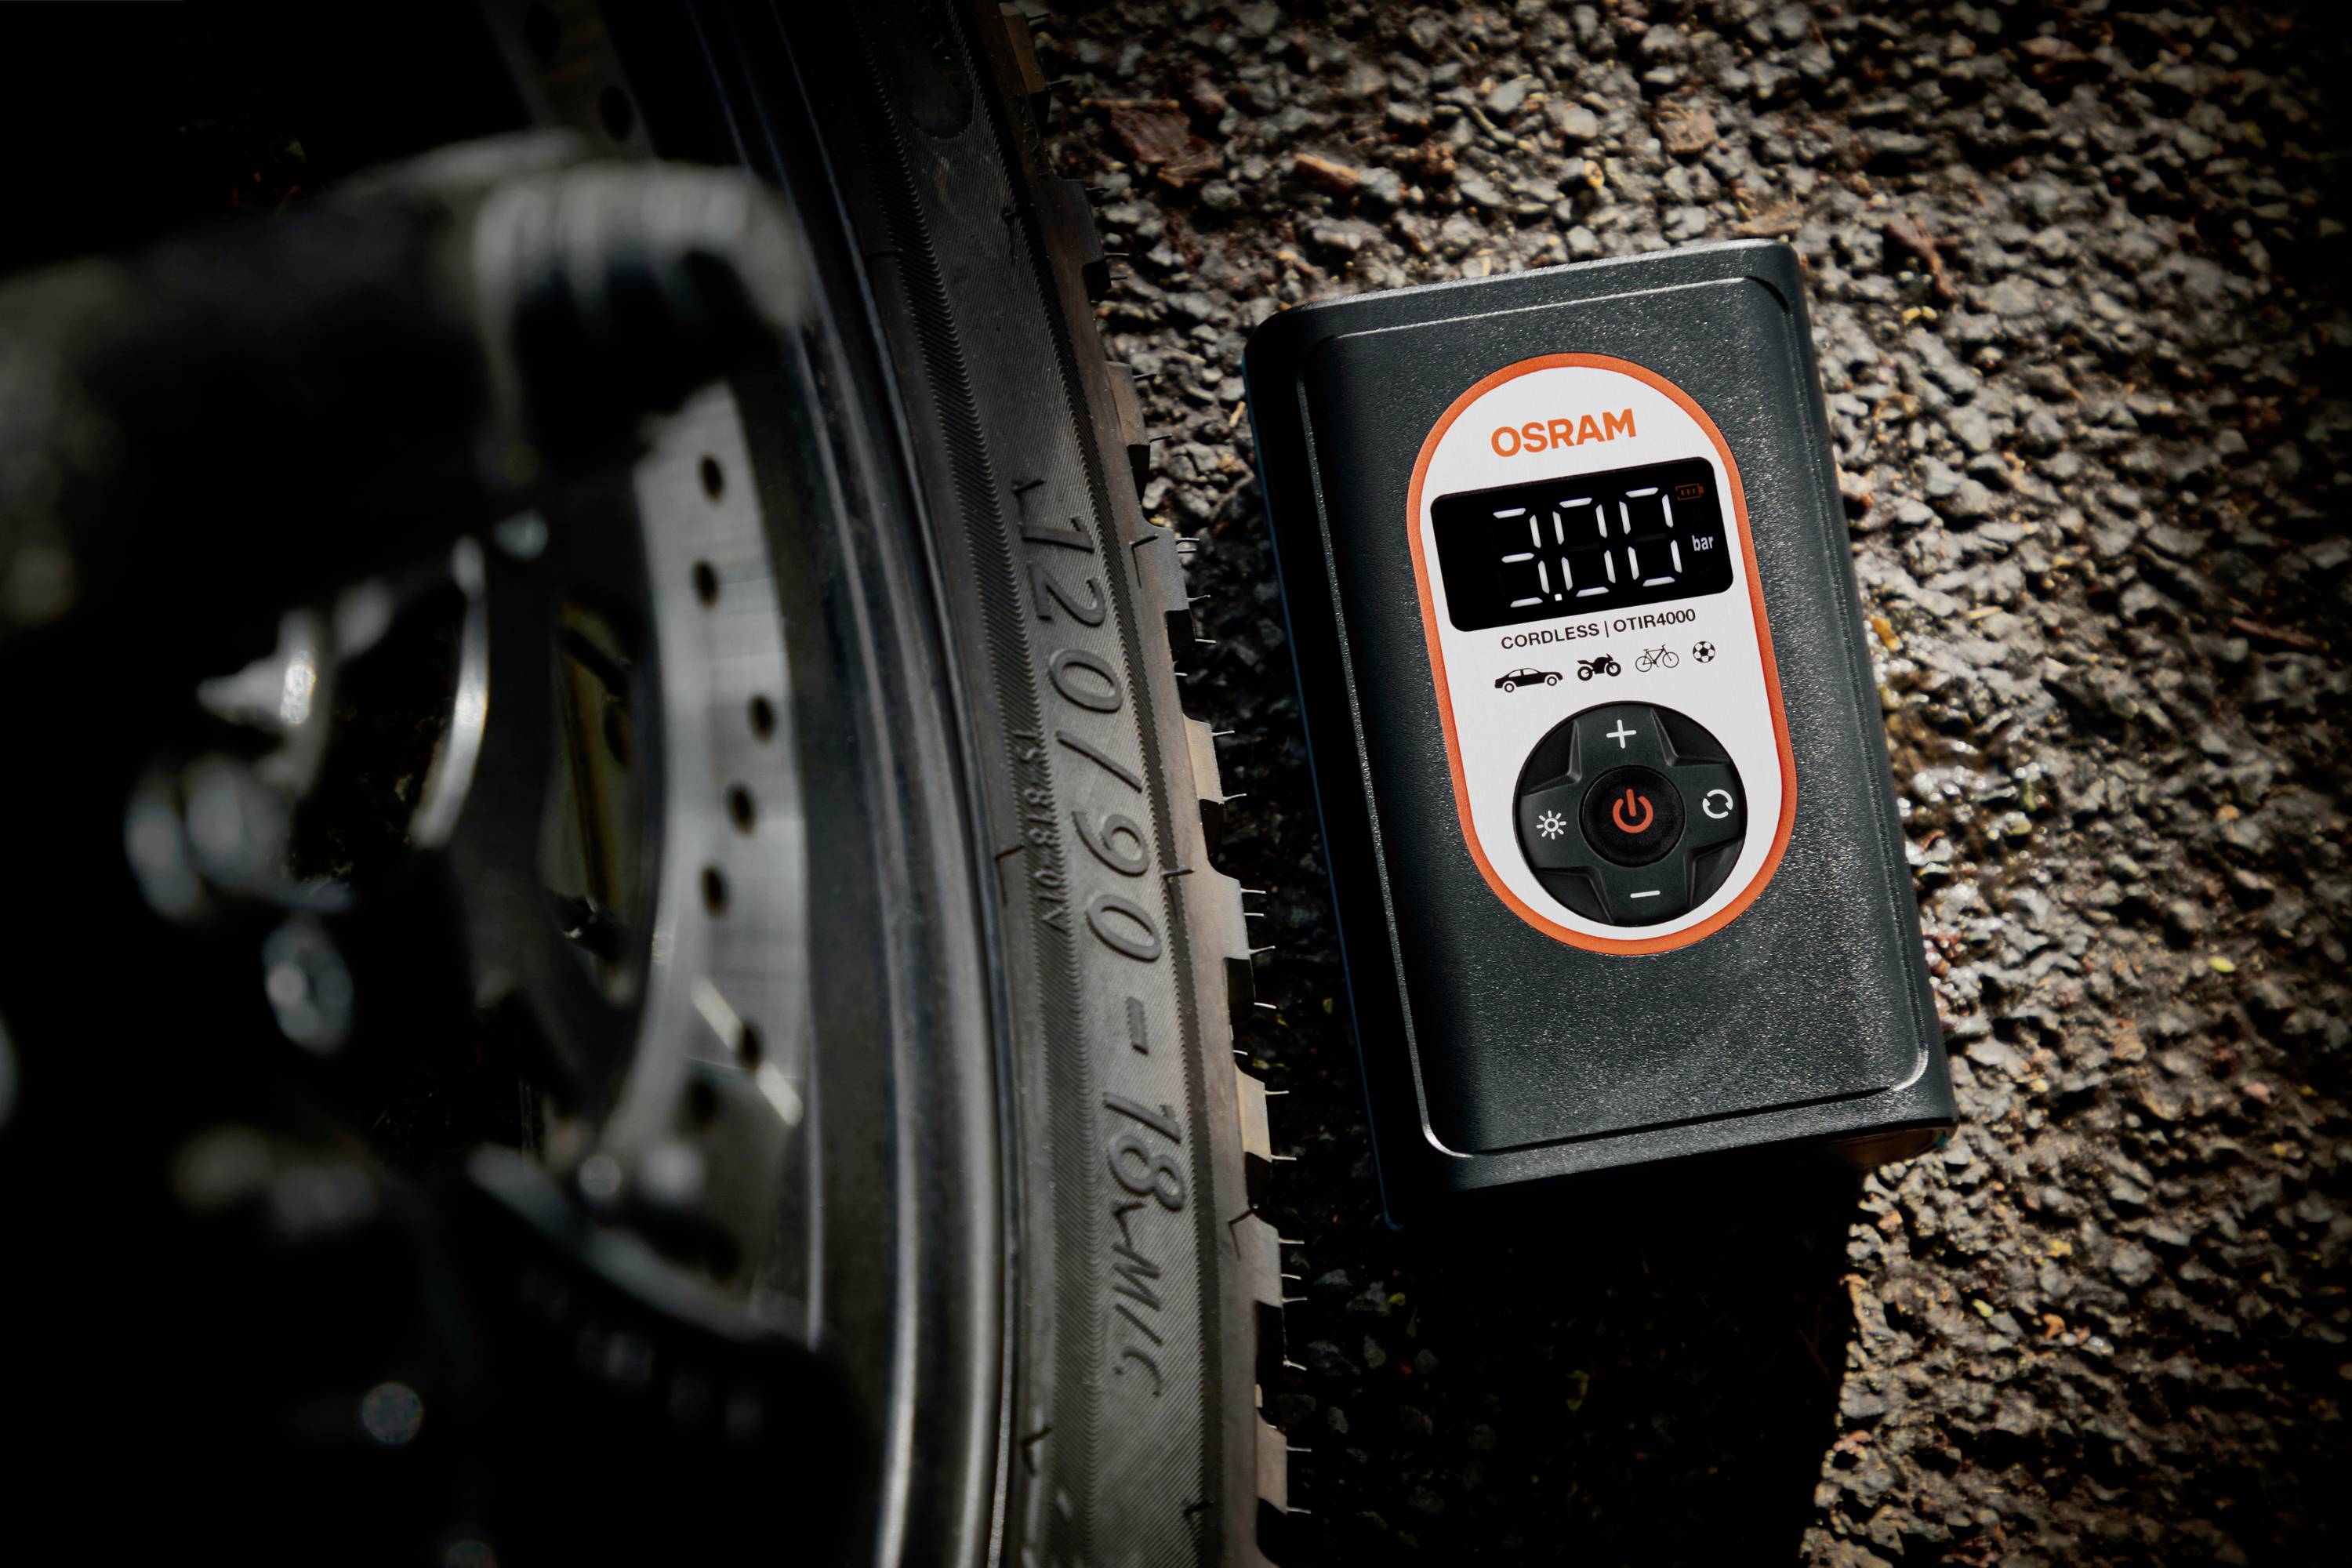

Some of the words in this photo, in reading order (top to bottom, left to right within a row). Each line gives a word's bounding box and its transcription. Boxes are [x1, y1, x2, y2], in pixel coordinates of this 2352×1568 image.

[1491, 408, 1637, 457] OSRAM
[1493, 487, 1682, 608] 3.00
[1691, 534, 1715, 552] bar
[1501, 622, 1600, 650] CORDLESS
[1613, 608, 1697, 633] OTIR4000
[1019, 515, 1162, 963] 120/90
[1102, 1091, 1186, 1211] 18
[1112, 1243, 1163, 1397] M/C
